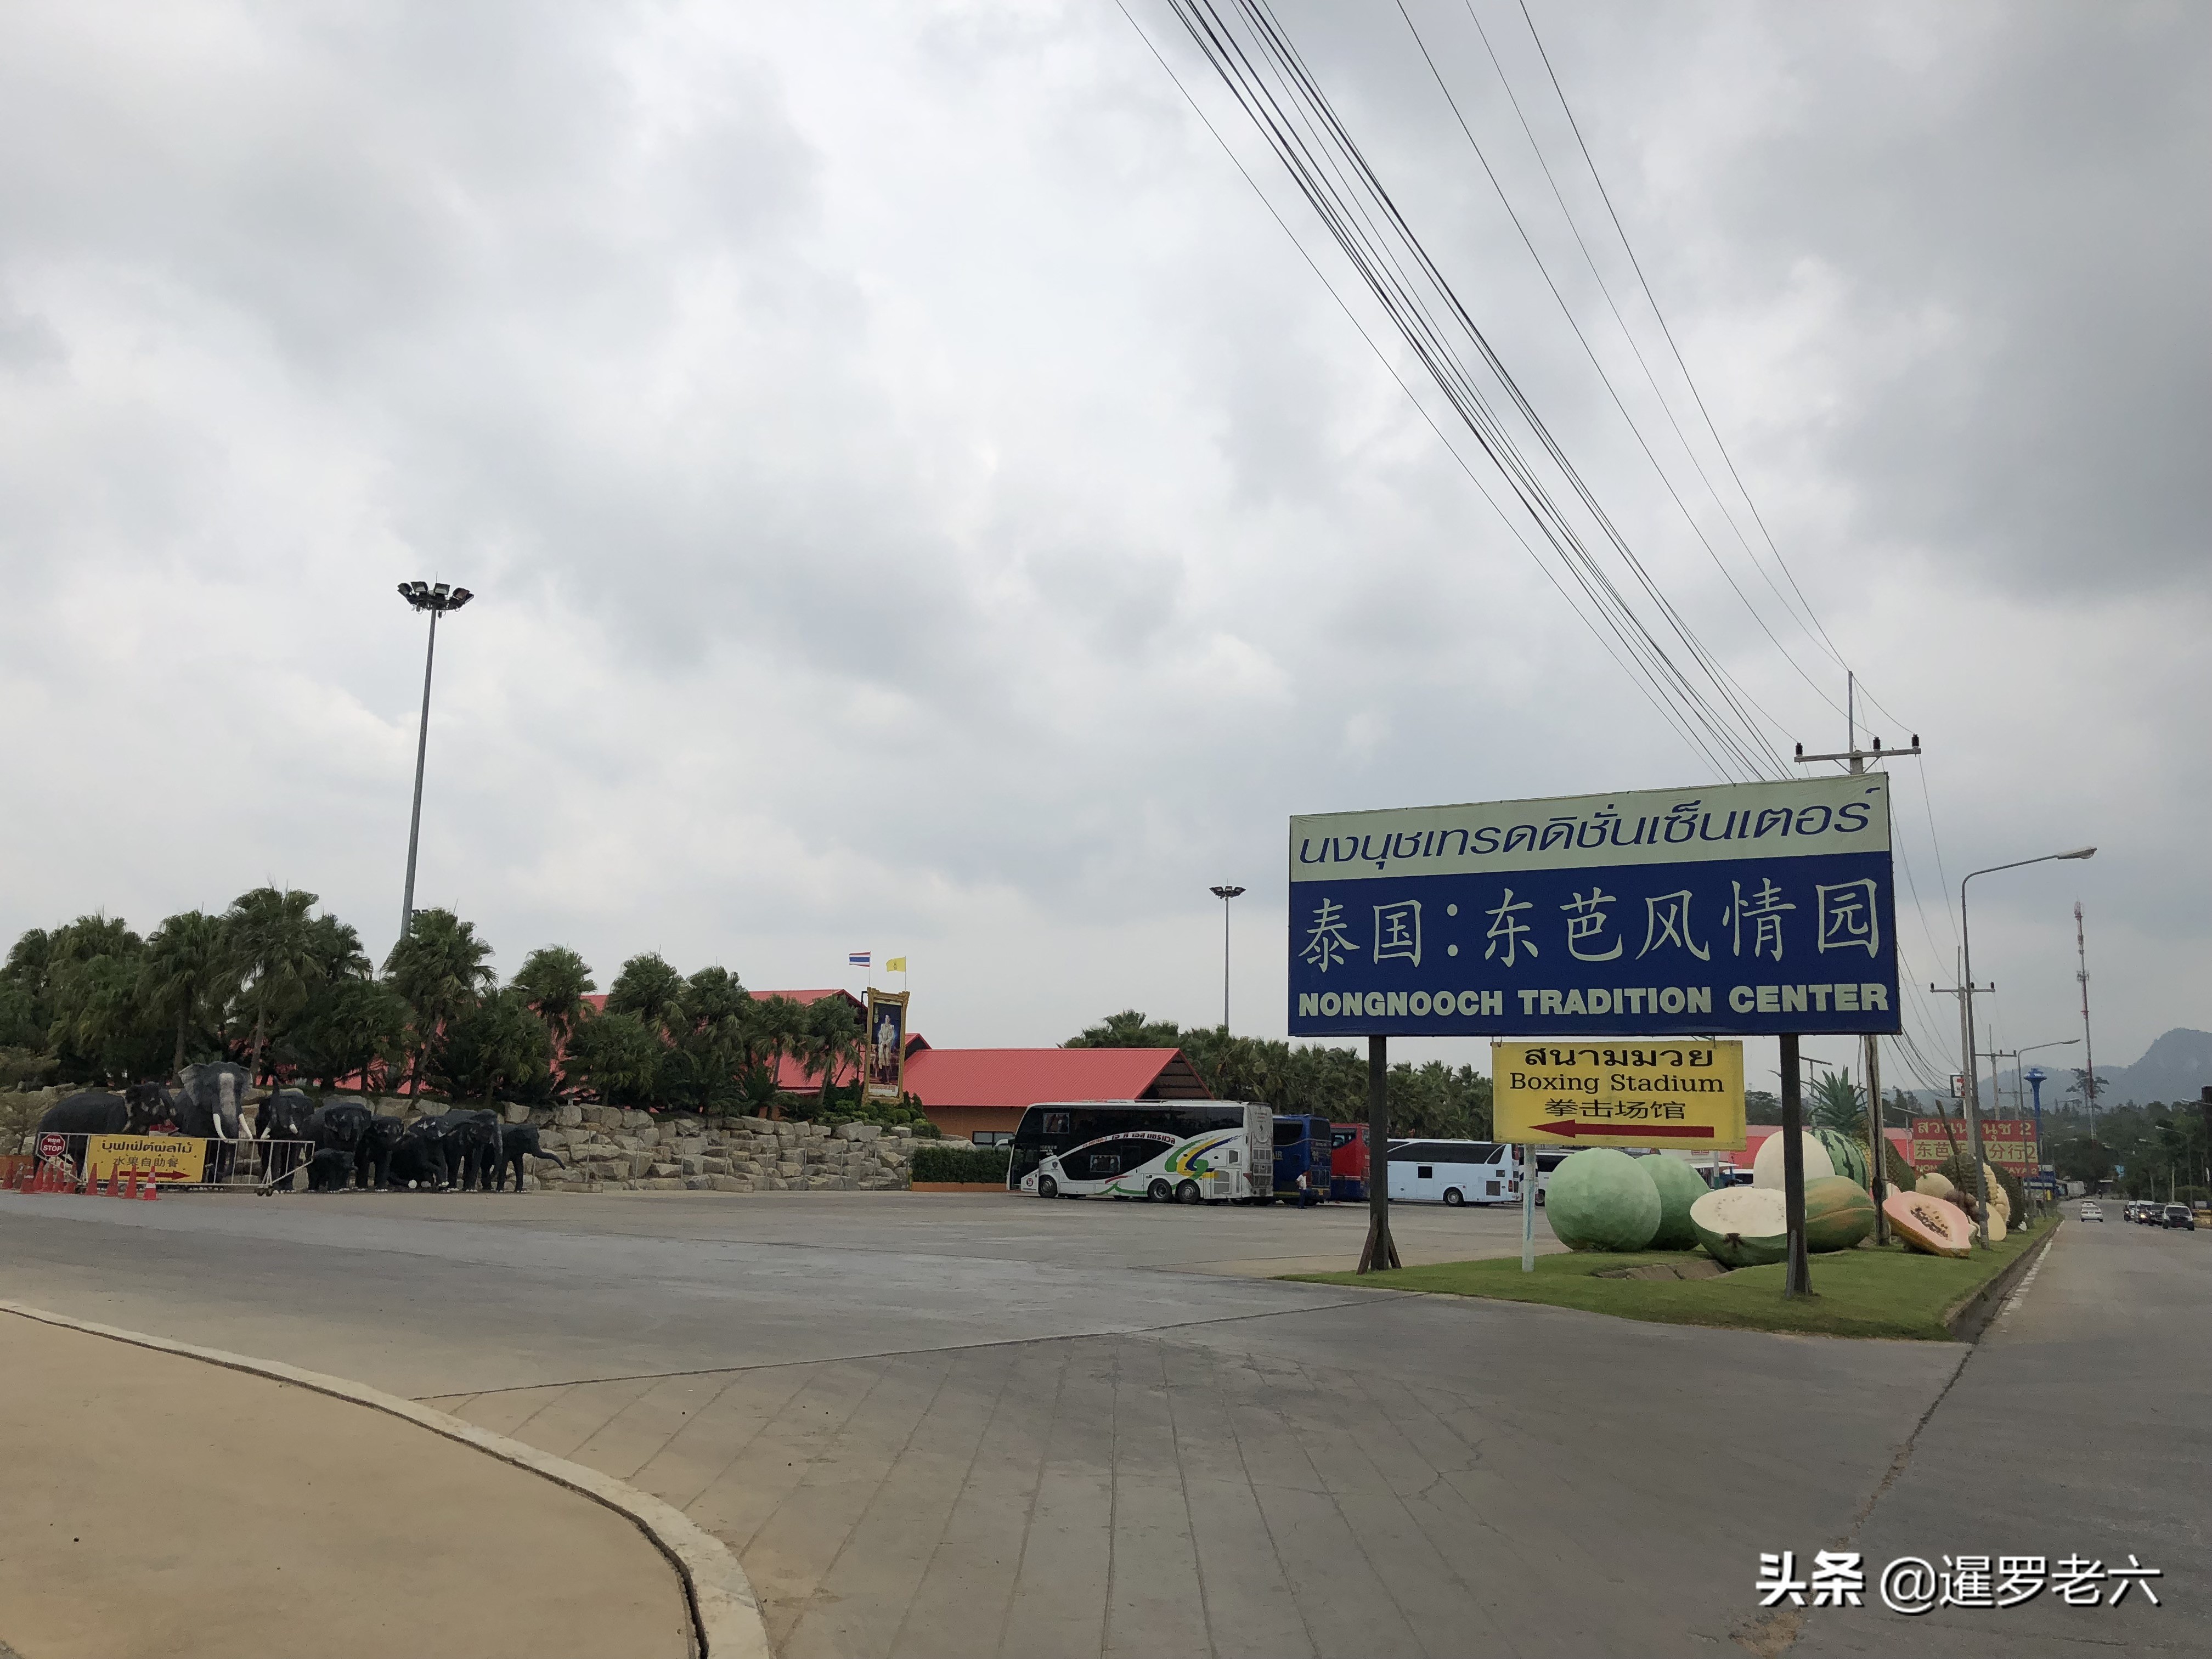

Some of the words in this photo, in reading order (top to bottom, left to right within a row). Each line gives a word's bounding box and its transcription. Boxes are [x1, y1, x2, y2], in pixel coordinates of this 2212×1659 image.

[1298, 787, 1880, 870] นงนุชเทรดดิชั่นเซ็นเตอร์
[1298, 990, 1503, 1018] NONGNOOCH
[1517, 986, 1712, 1015] TRADITION
[1729, 983, 1889, 1013] CENTER
[1525, 1047, 1714, 1066] สนามมวย
[1510, 1073, 1600, 1094] Boxing
[1611, 1074, 1725, 1092] Stadium
[1544, 1098, 1686, 1120] 拳击场馆
[113, 1156, 179, 1167] 水果自助餐
